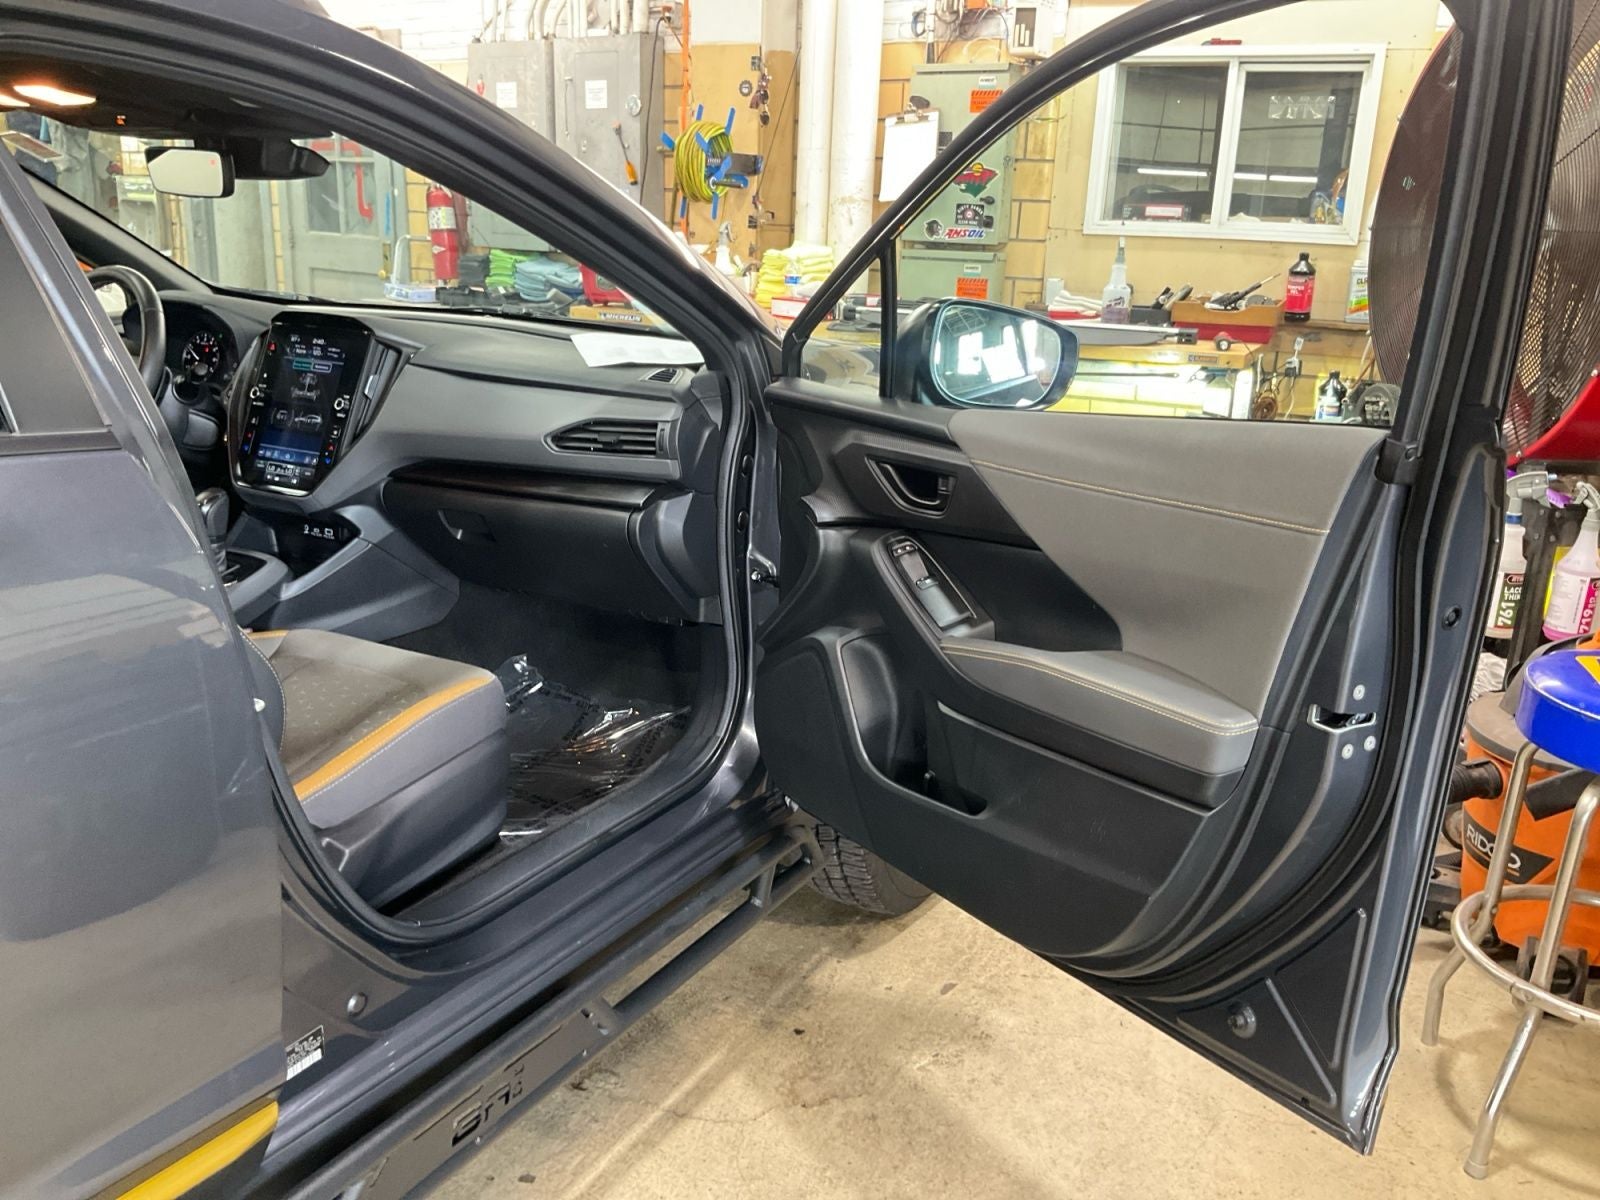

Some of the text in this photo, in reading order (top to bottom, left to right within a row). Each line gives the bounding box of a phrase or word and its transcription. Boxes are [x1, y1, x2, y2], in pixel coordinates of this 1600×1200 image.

[945, 229, 984, 239] AMSOIL
[606, 313, 640, 321] MICHELIN
[1497, 602, 1515, 626] 761
[1579, 609, 1592, 633] 719
[1466, 823, 1521, 869] RIDD
